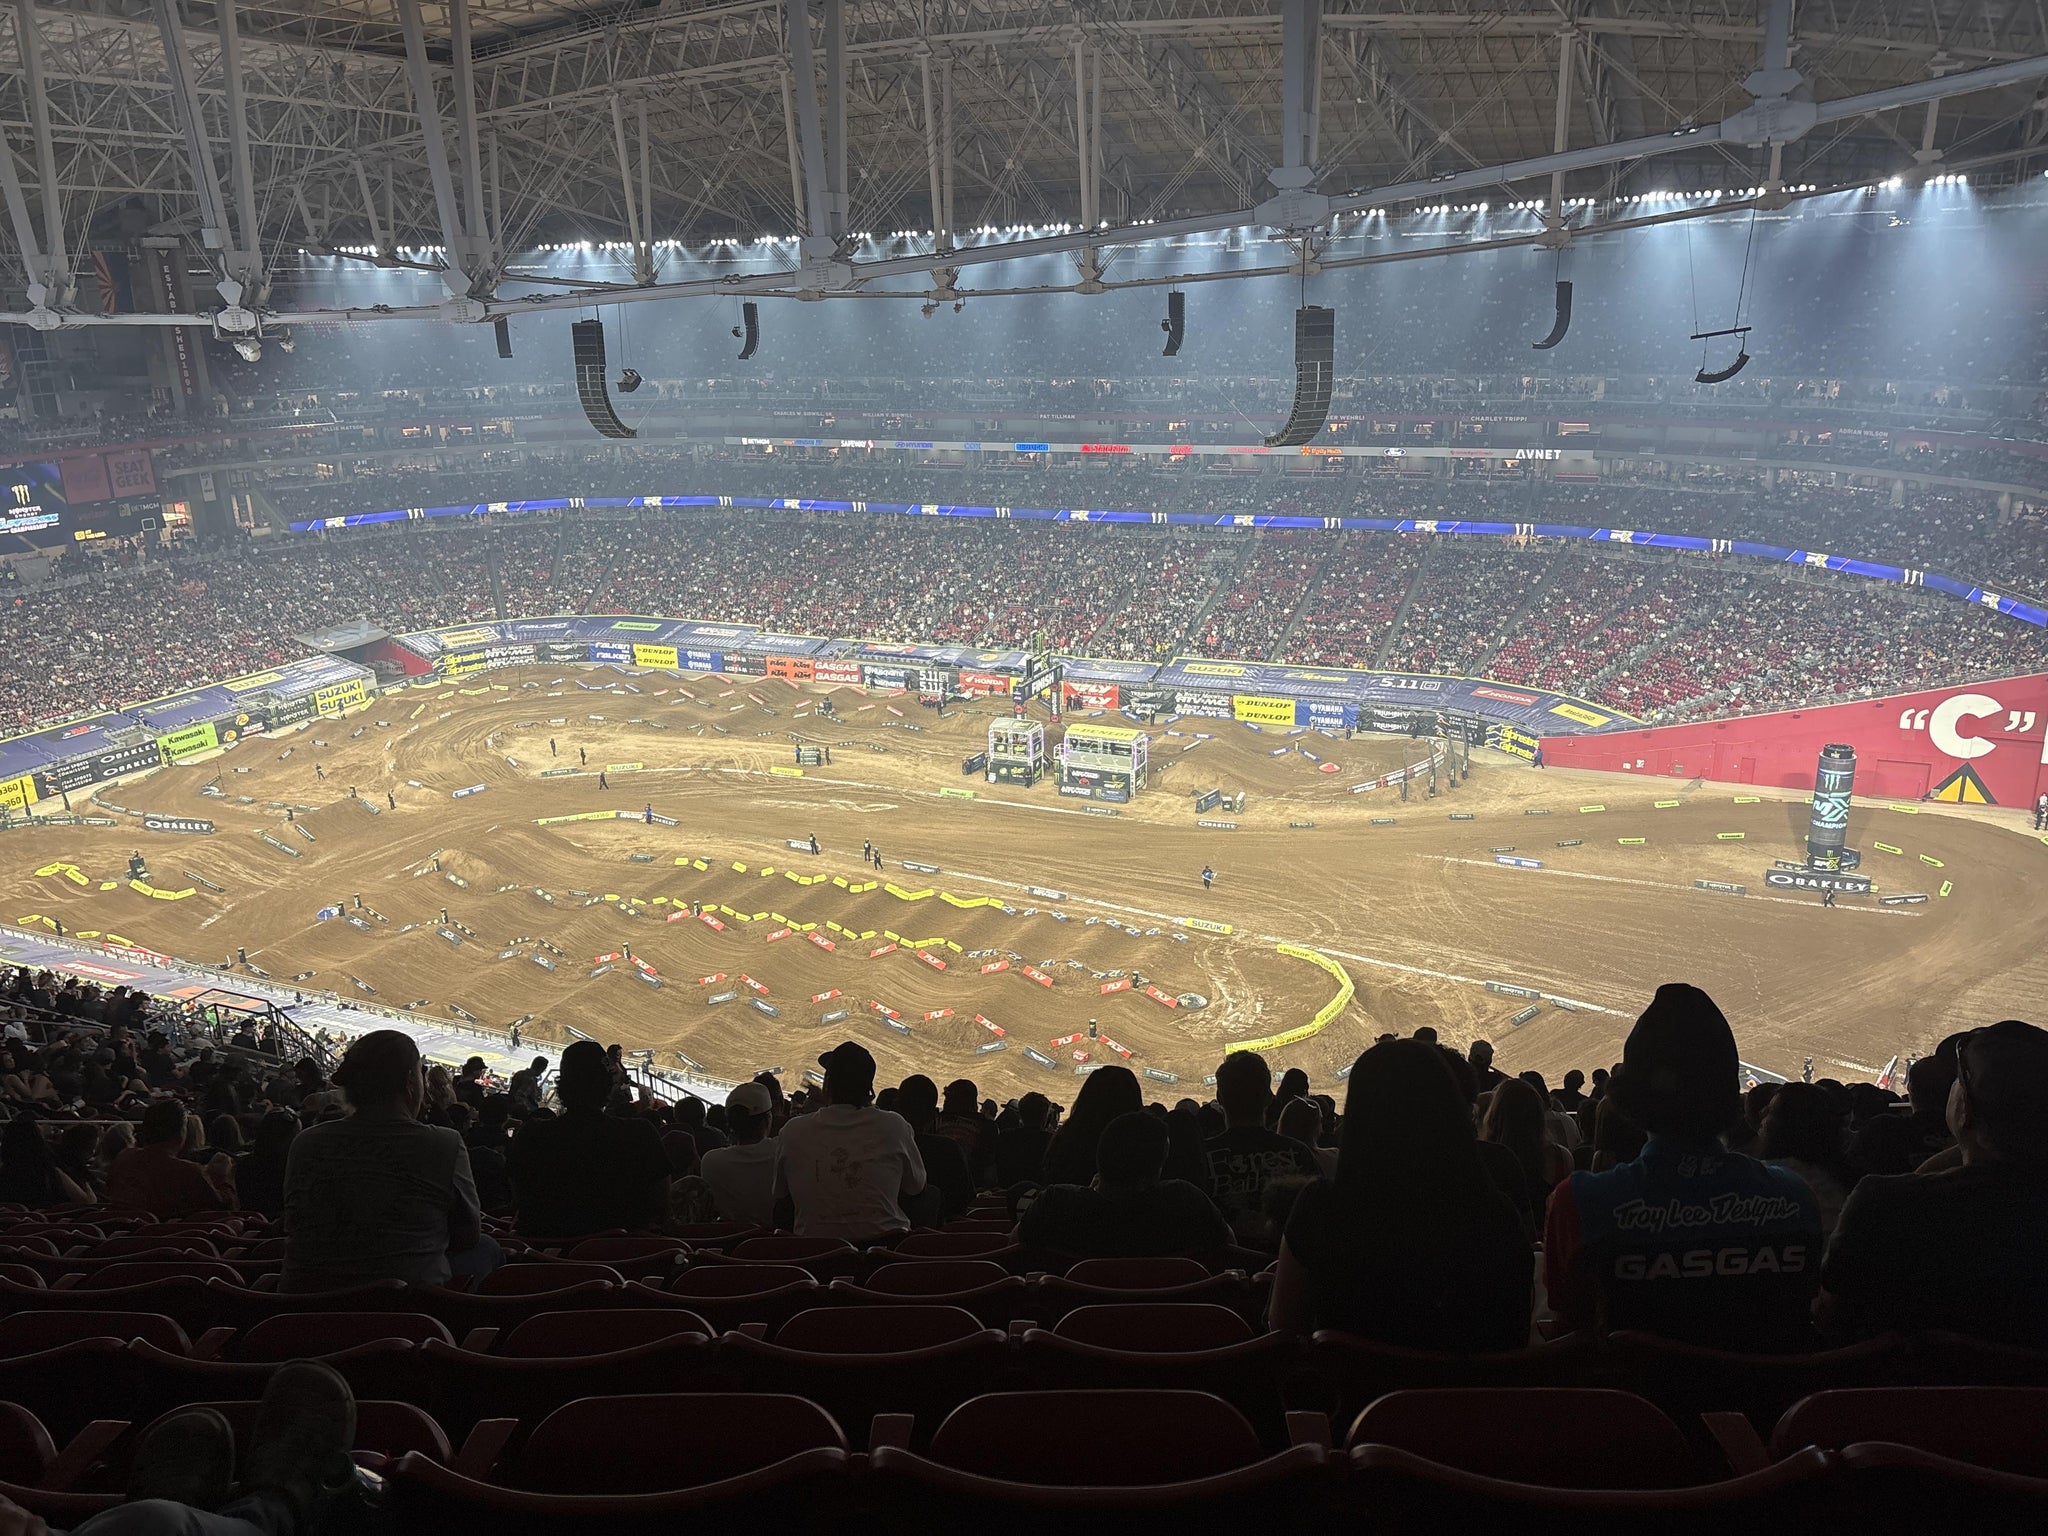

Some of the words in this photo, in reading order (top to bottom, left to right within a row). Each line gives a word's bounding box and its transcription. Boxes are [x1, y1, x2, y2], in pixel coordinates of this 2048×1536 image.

[164, 265, 186, 360] ESTABSHED
[1838, 428, 1863, 436] ADRIAN
[1863, 430, 1888, 438] WILSON
[1516, 448, 1562, 460] AVNET
[114, 460, 146, 474] SEAT
[118, 474, 151, 488] GEEK
[596, 652, 630, 660] FALKEN
[642, 648, 674, 656] DUNLOP
[643, 658, 676, 666] DUNLOP
[814, 662, 858, 672] GASGAS
[1186, 665, 1243, 674] SUZUKI
[816, 672, 858, 682] GASGAS
[919, 670, 940, 682] 5.11
[920, 681, 939, 692] 5.11
[974, 678, 1004, 686] HONDA
[1032, 671, 1055, 694] FINISH
[1379, 678, 1418, 690] 5.11
[318, 682, 361, 700] SUZUKI
[1068, 682, 1114, 694] FLY
[320, 693, 364, 712] SUZUKI
[1490, 692, 1532, 703] HONDA
[1246, 700, 1291, 710] DUNLOP
[1318, 704, 1344, 713] YAMAHA
[280, 709, 309, 722] MONSTER
[1245, 712, 1290, 722] DUNLOP
[1373, 710, 1402, 718] TRIUMPH
[1316, 717, 1344, 725] YAMAHA
[1372, 722, 1402, 730] TRIUMPH
[168, 728, 206, 744] Kawasaki
[1079, 728, 1134, 738] DUNLOP
[116, 742, 157, 760] OAKLEY
[170, 738, 208, 756] Kawasaki
[56, 765, 70, 774] UTAH
[71, 760, 90, 770] SPORTS
[118, 754, 160, 772] OAKLEY
[74, 772, 92, 783] SPORTS
[162, 822, 208, 831] OAKLEY
[1796, 878, 1867, 891] OAKLEY
[671, 911, 684, 920] FLY
[704, 914, 718, 926] FLY
[1191, 920, 1226, 932] SUZUKI
[772, 930, 785, 938] FLY
[815, 936, 828, 946] FLY
[876, 946, 888, 955] FLY
[1283, 948, 1310, 958] DUNLOP
[599, 954, 612, 962] FLY
[634, 958, 648, 968] FLY
[924, 954, 939, 964] FLY
[987, 962, 1001, 970] FLY
[704, 974, 718, 983] FLY
[1030, 970, 1046, 981] FLY
[746, 978, 761, 989] FLY
[1108, 982, 1122, 990] FLY
[818, 991, 832, 1000] FLY
[1154, 990, 1170, 1000] FLY
[876, 1004, 892, 1014] FLY
[930, 1010, 944, 1018] FLY
[981, 1019, 998, 1030] FLY
[1058, 1036, 1073, 1045] FLY
[1286, 1029, 1317, 1043] DUNLOP
[1107, 1041, 1125, 1052] FLY
[1613, 1198, 1666, 1232] Troy
[1666, 1199, 1712, 1228] Lee
[1709, 1192, 1800, 1226] Designs
[1614, 1246, 1806, 1280] GASGAS
